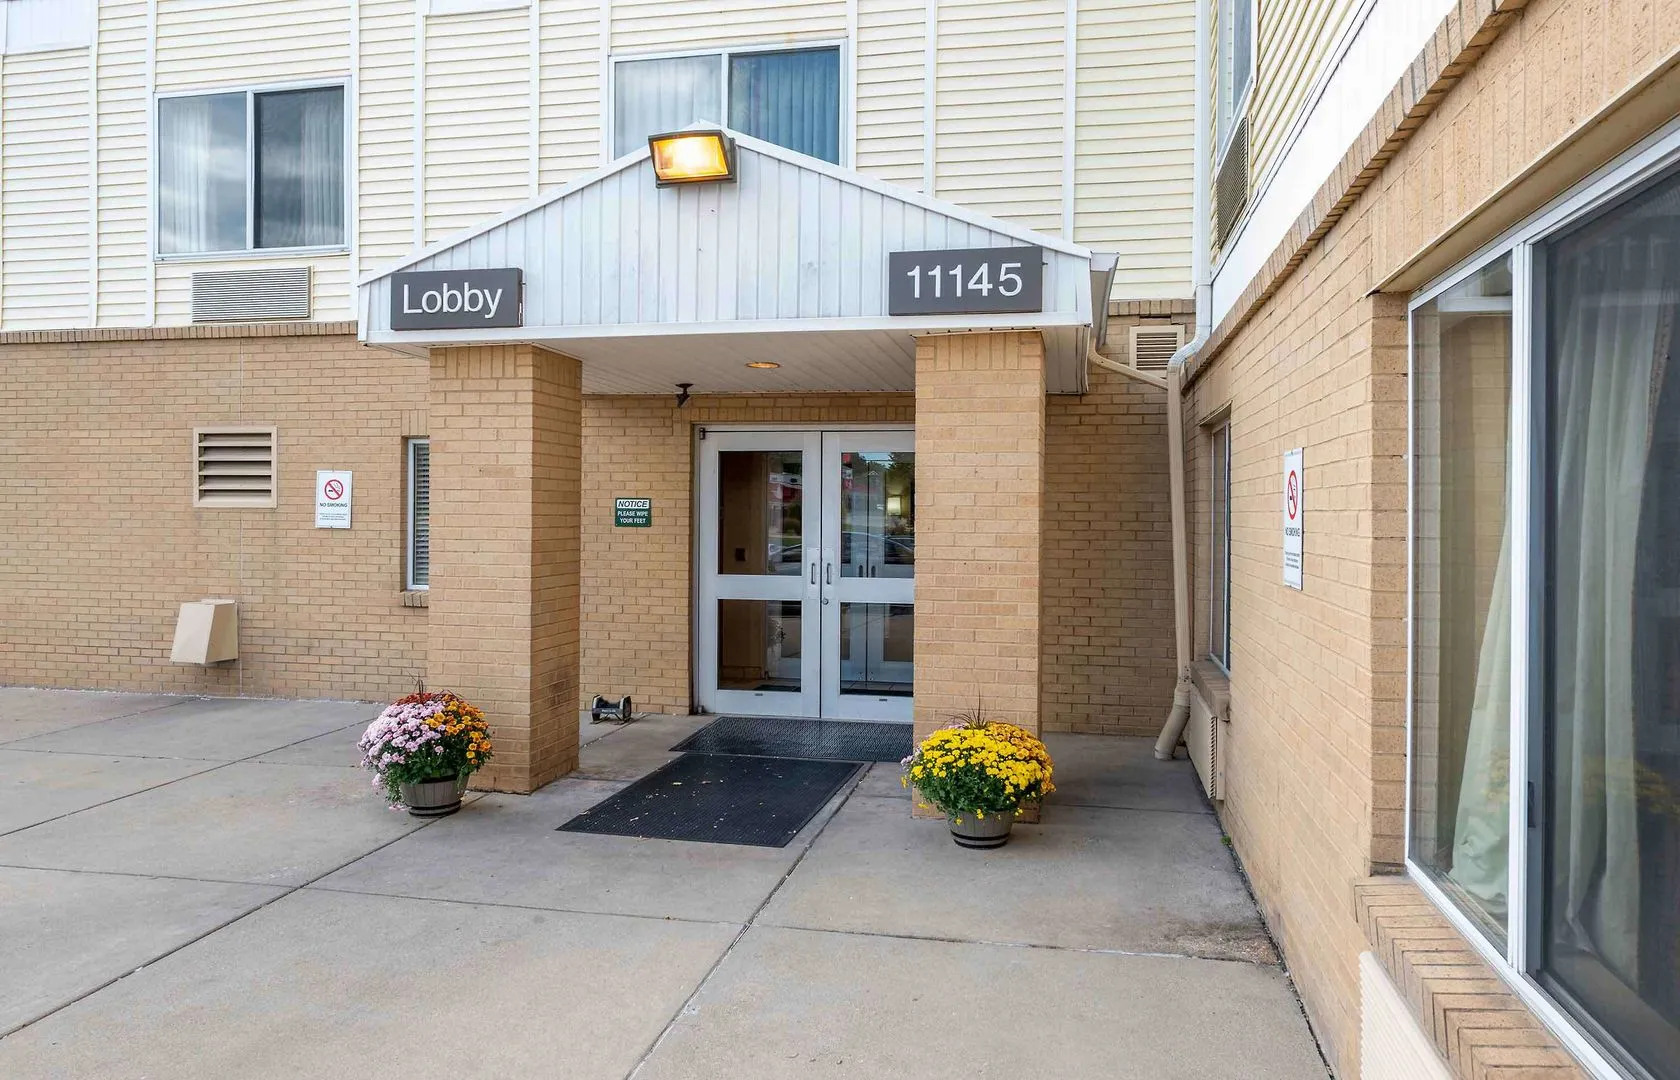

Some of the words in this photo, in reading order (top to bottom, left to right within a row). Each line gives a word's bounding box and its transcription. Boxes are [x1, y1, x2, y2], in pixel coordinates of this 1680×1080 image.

[906, 262, 1023, 299] 11145
[403, 282, 503, 319] Lobby
[617, 500, 649, 508] NOTICE
